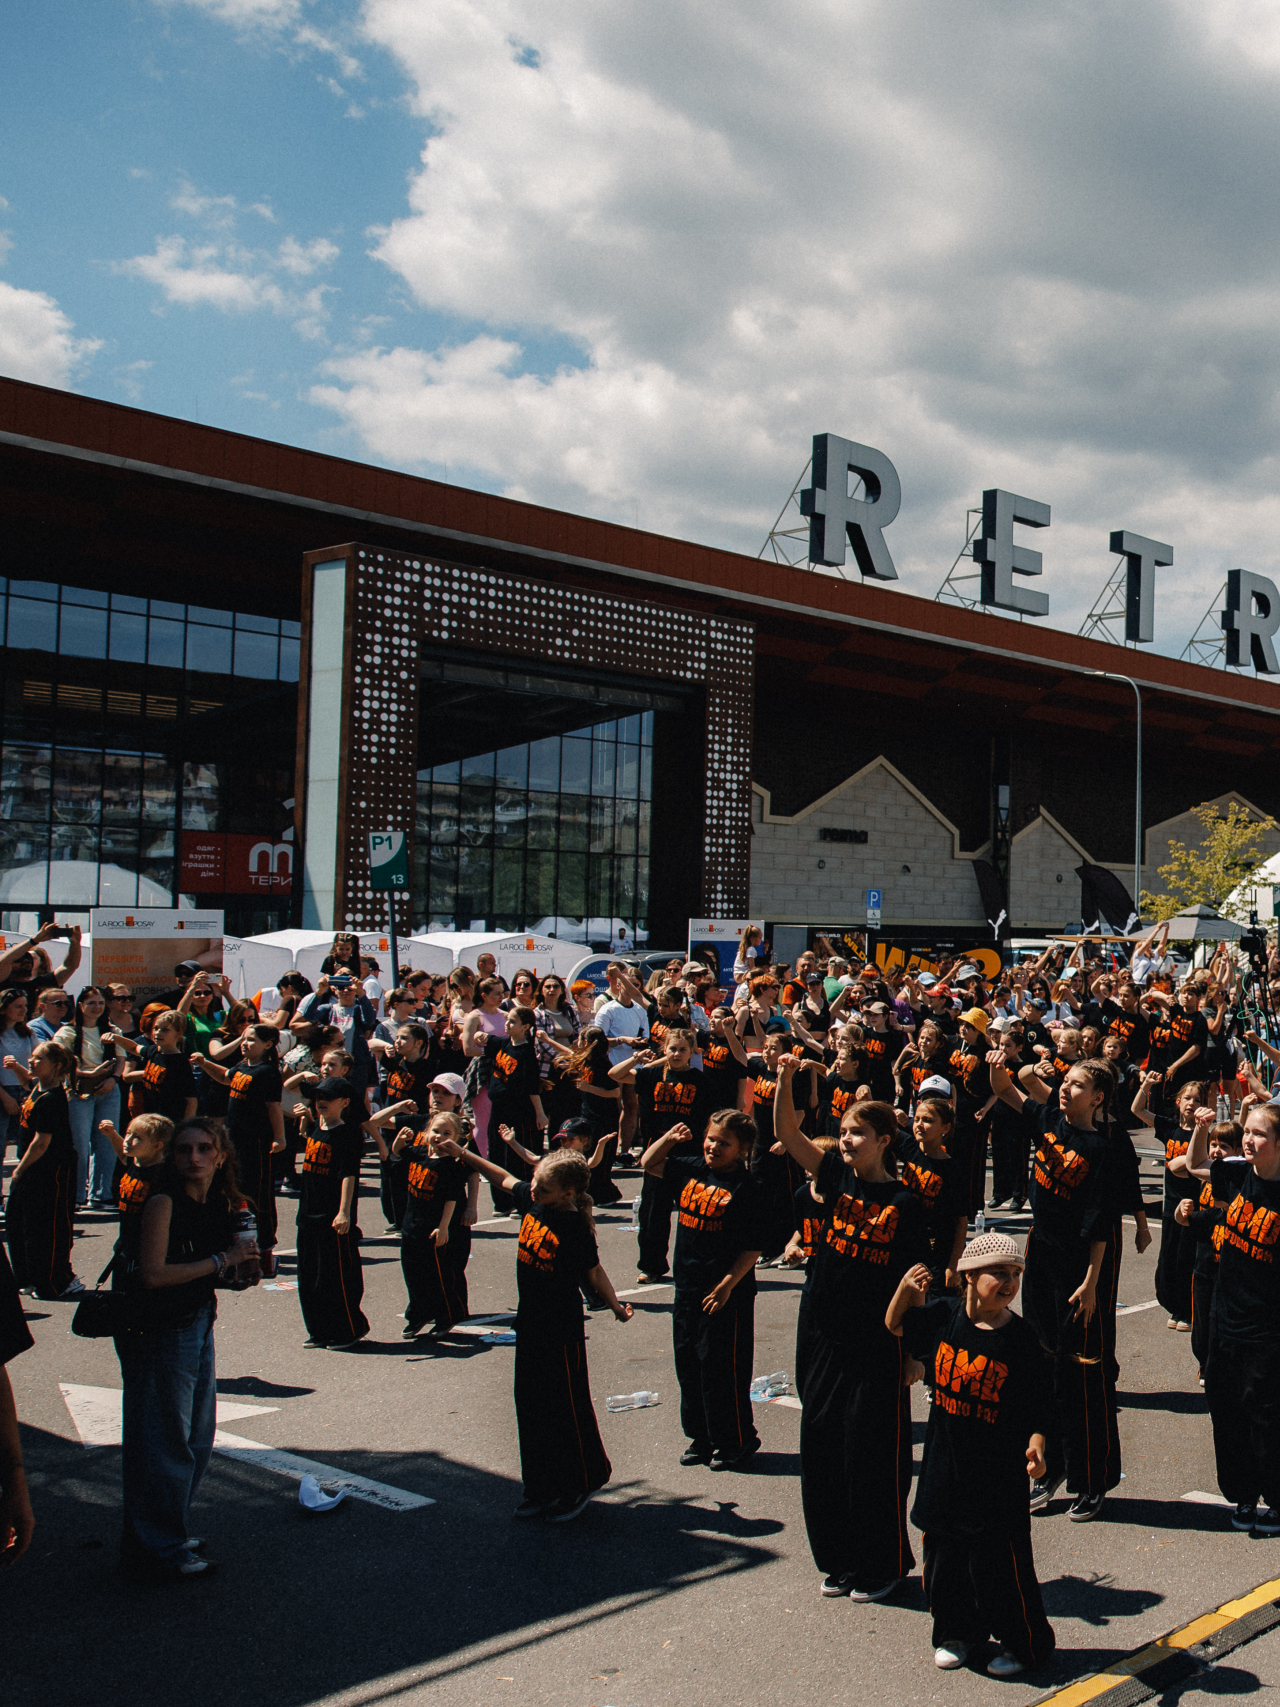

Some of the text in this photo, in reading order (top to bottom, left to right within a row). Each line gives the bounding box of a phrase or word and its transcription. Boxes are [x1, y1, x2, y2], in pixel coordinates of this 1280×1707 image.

[372, 835, 393, 851] P1
[182, 861, 215, 869] іграшки
[200, 870, 215, 878] дім
[391, 875, 404, 885] 13
[870, 892, 878, 907] P
[843, 934, 867, 962] WILD
[97, 955, 144, 963] ПЕРЕВІРТЕ
[97, 966, 148, 974] РОДИМКИ
[653, 1081, 697, 1105] DMD
[680, 1178, 732, 1217] DMD
[699, 1219, 723, 1232] FAM
[833, 1193, 900, 1244] DMD
[518, 1213, 560, 1260] DMD
[862, 1246, 890, 1265] FAM
[1251, 1245, 1274, 1264] FAM
[935, 1340, 1010, 1402] DMD
[935, 1389, 971, 1417] STUDIO
